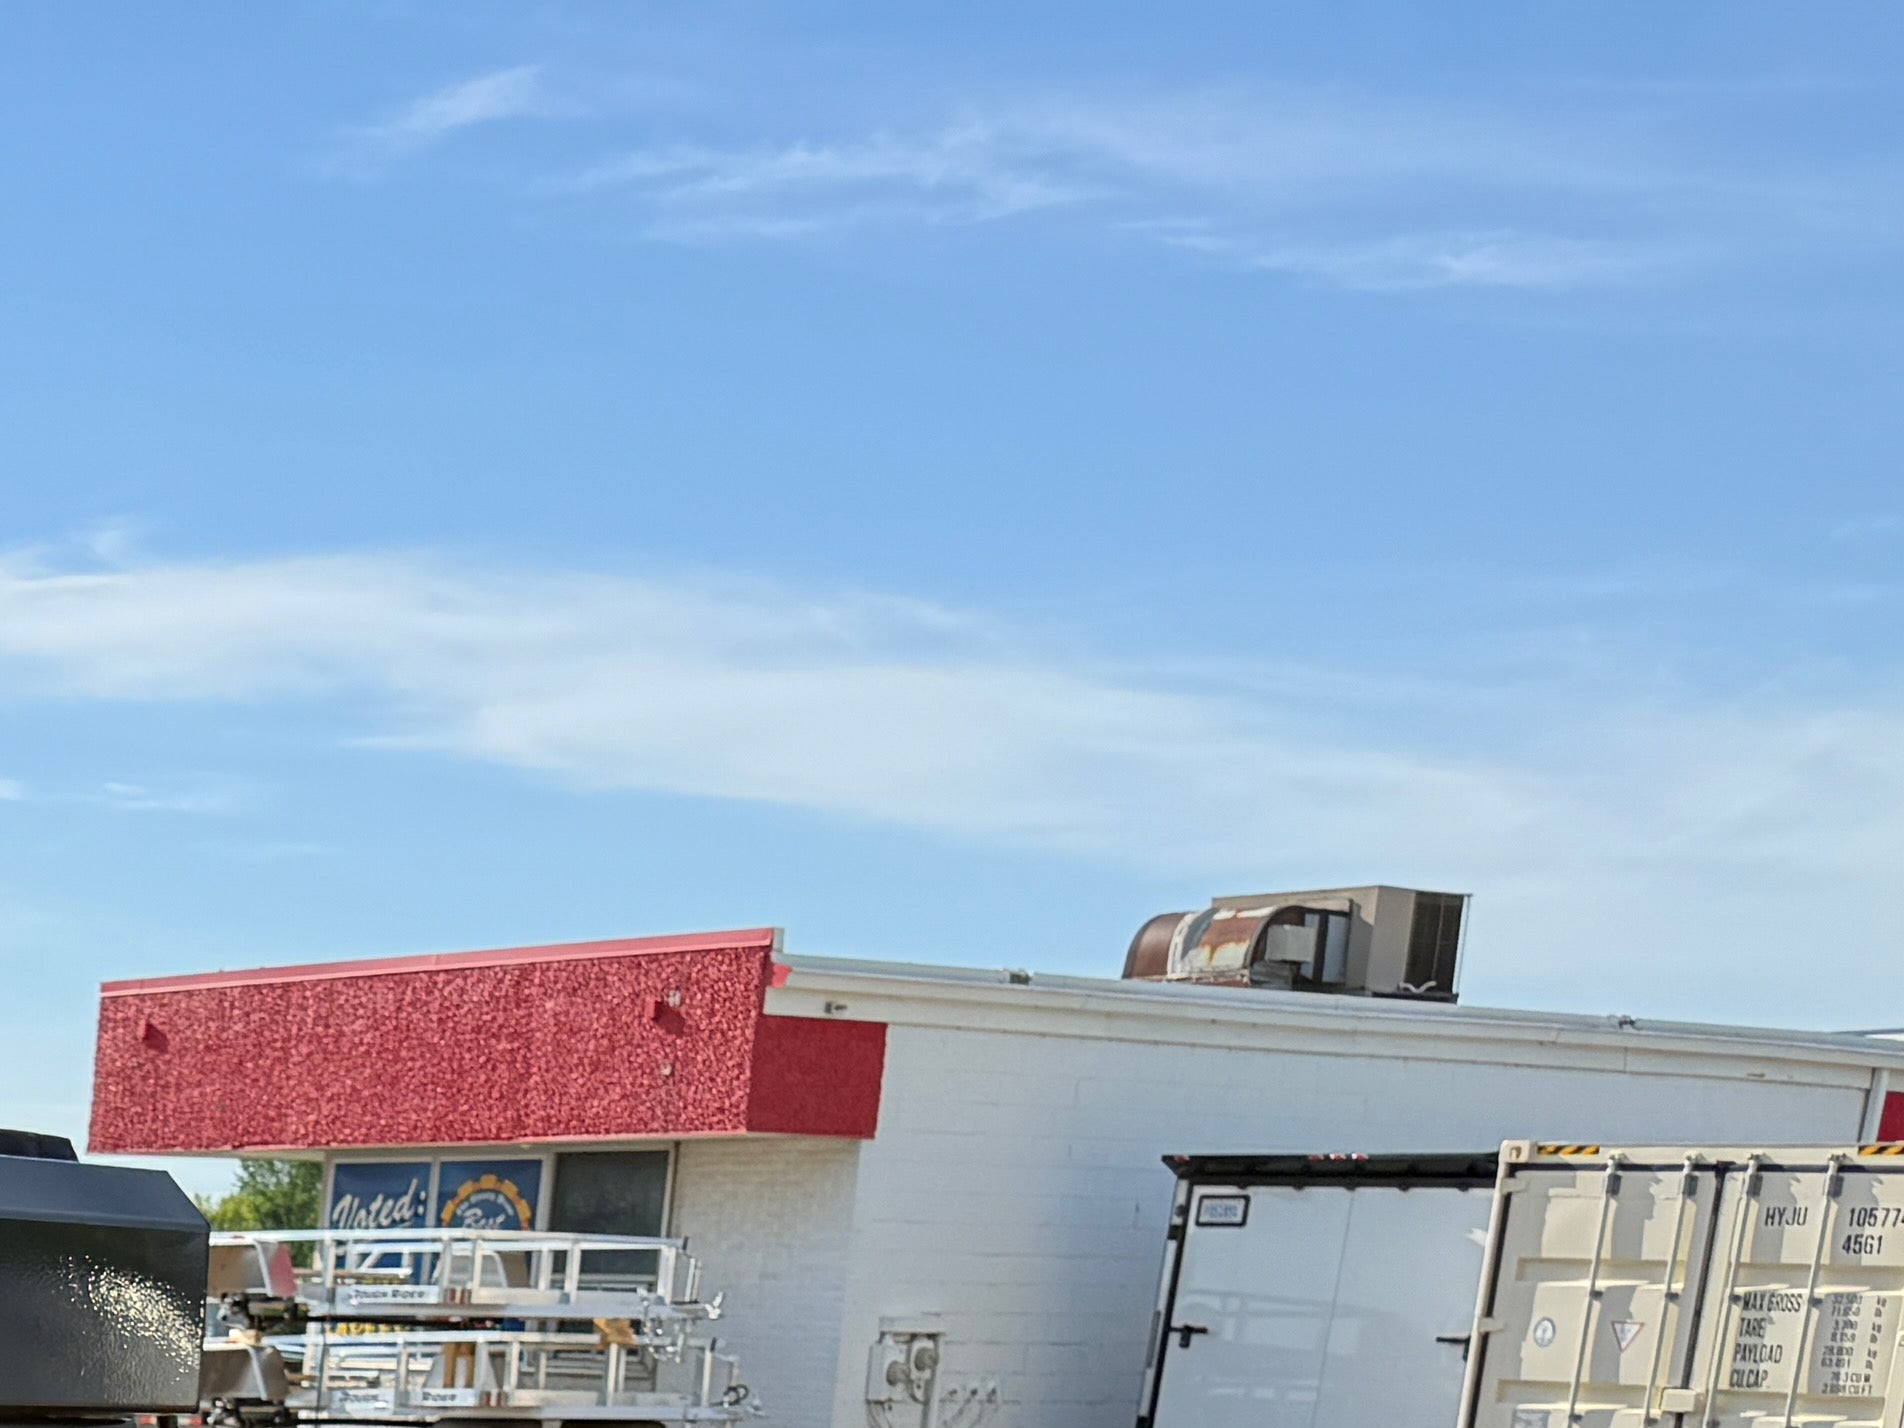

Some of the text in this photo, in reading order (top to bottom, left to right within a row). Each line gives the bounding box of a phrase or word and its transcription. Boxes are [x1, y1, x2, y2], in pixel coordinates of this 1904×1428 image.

[1764, 1207, 1904, 1228] HYJU 10577
[1842, 1234, 1883, 1255] 45G1
[1767, 1293, 1804, 1313] GROSS
[1739, 1317, 1766, 1338] TARE
[1733, 1343, 1783, 1364] PAYLOAD
